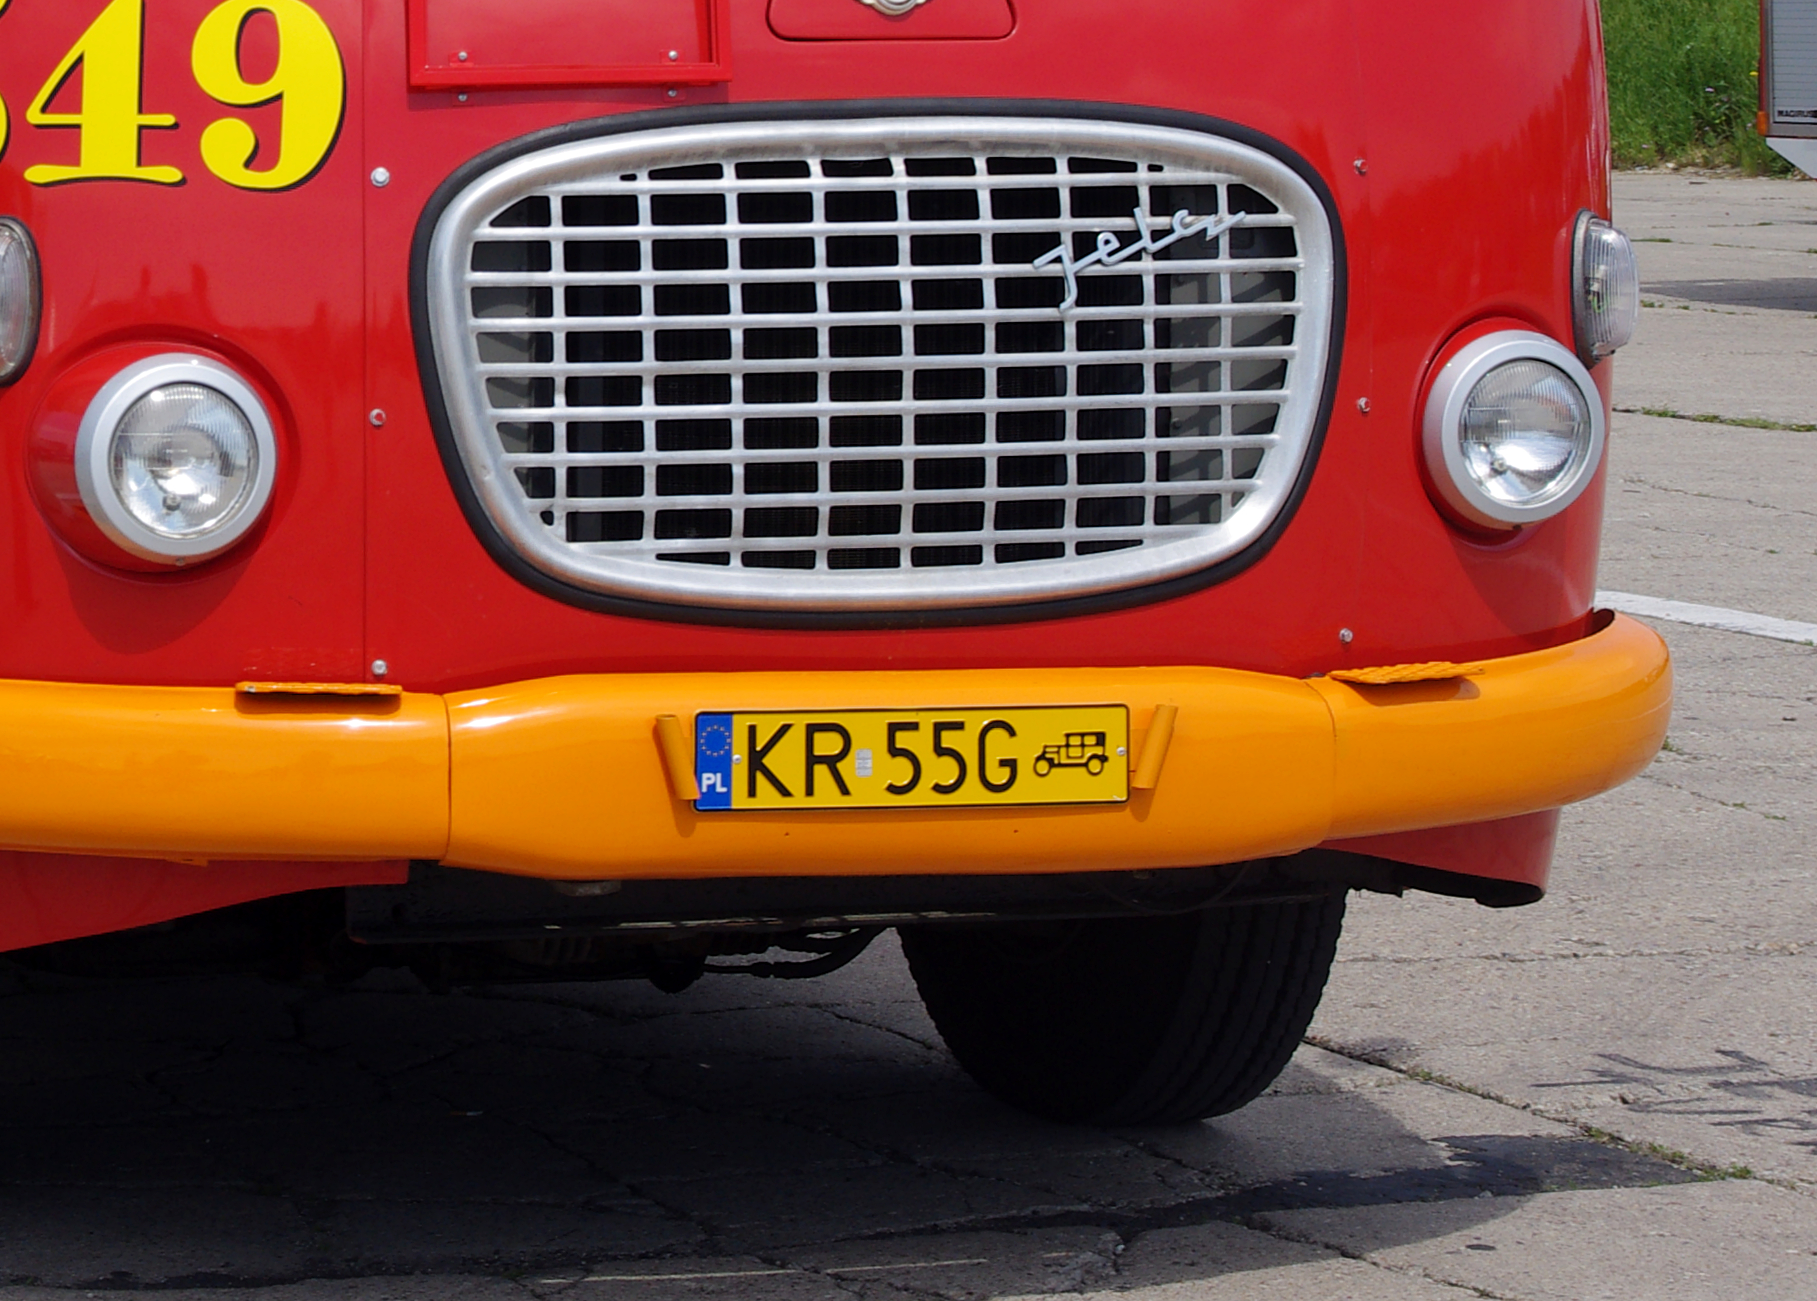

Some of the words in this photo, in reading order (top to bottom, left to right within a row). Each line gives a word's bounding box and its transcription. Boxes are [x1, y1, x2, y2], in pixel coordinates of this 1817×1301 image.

[700, 772, 728, 794] PL
[746, 721, 853, 799] KR
[884, 718, 1018, 796] 55G
